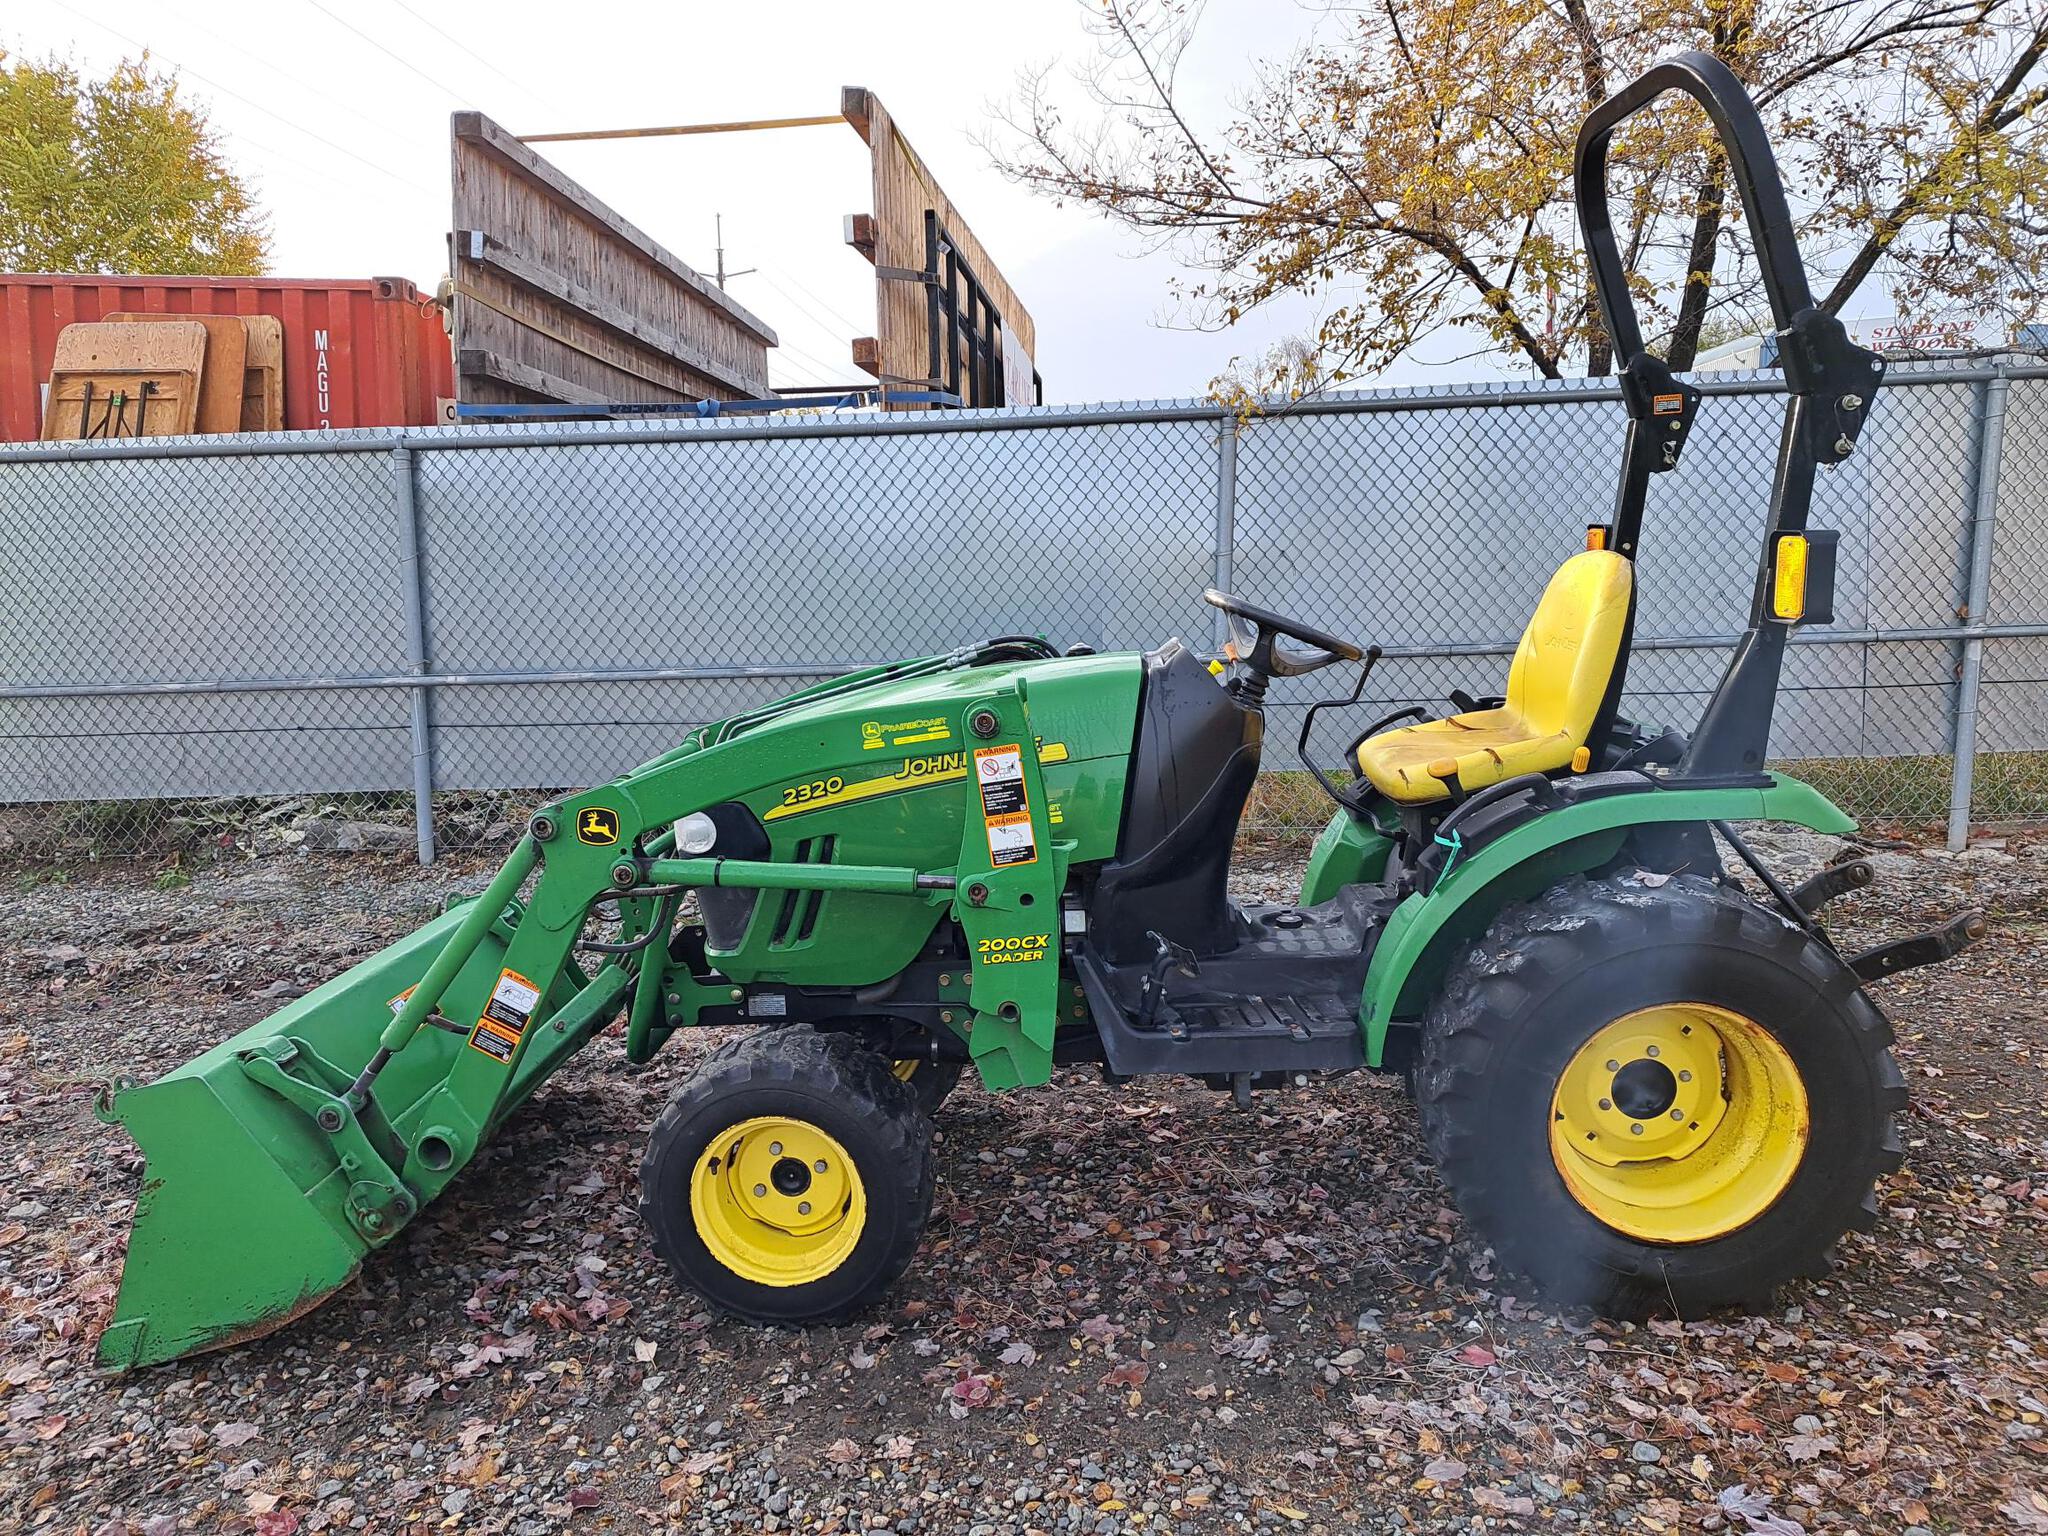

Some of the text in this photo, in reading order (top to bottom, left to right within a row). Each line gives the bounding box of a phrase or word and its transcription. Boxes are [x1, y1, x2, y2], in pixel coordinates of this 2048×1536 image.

[314, 329, 329, 413] MAGU
[983, 745, 1017, 755] WARNING
[894, 752, 959, 779] JOHN
[783, 776, 845, 806] 2320
[994, 814, 1029, 825] WARNING
[977, 933, 1050, 952] 200CX
[983, 950, 1044, 965] LOADER
[490, 1024, 516, 1041] WARNING
